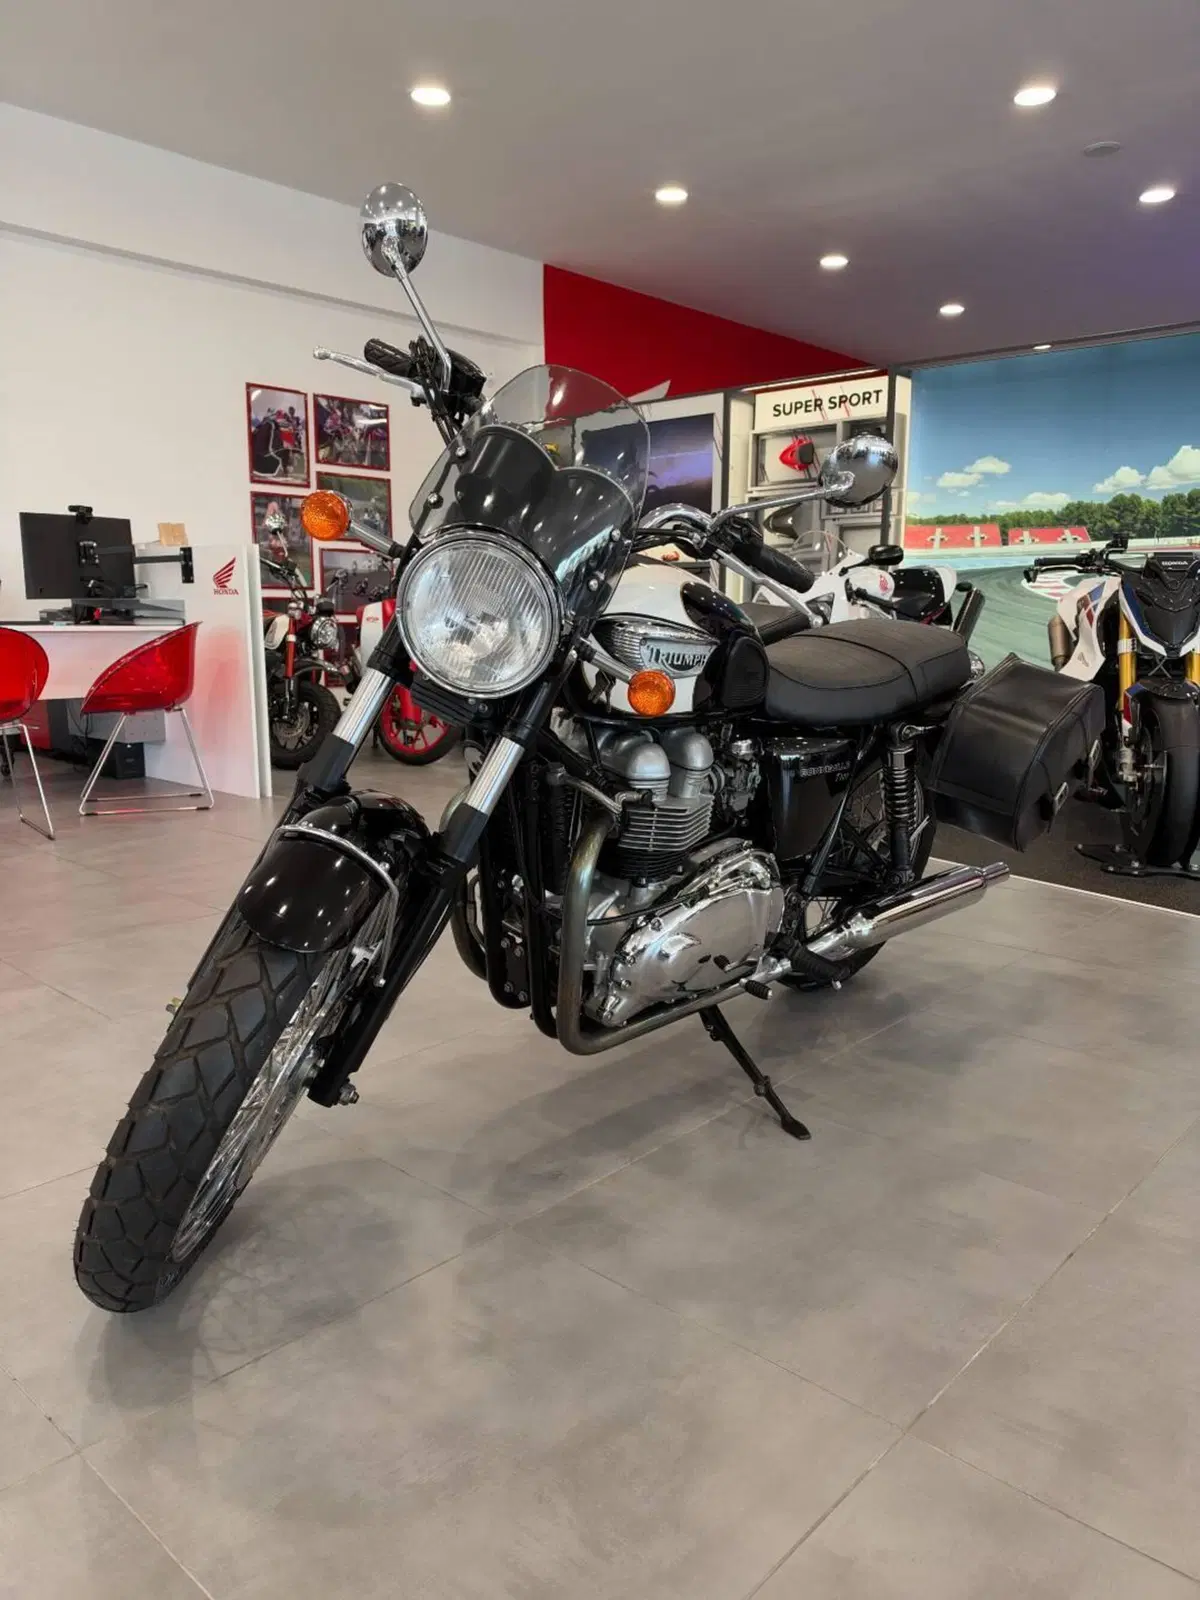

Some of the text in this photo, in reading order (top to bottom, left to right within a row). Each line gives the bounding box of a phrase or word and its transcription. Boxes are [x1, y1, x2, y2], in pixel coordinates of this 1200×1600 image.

[772, 389, 883, 418] SUPER SPORT
[213, 588, 239, 596] HONDA
[646, 644, 707, 667] TRIUMPH
